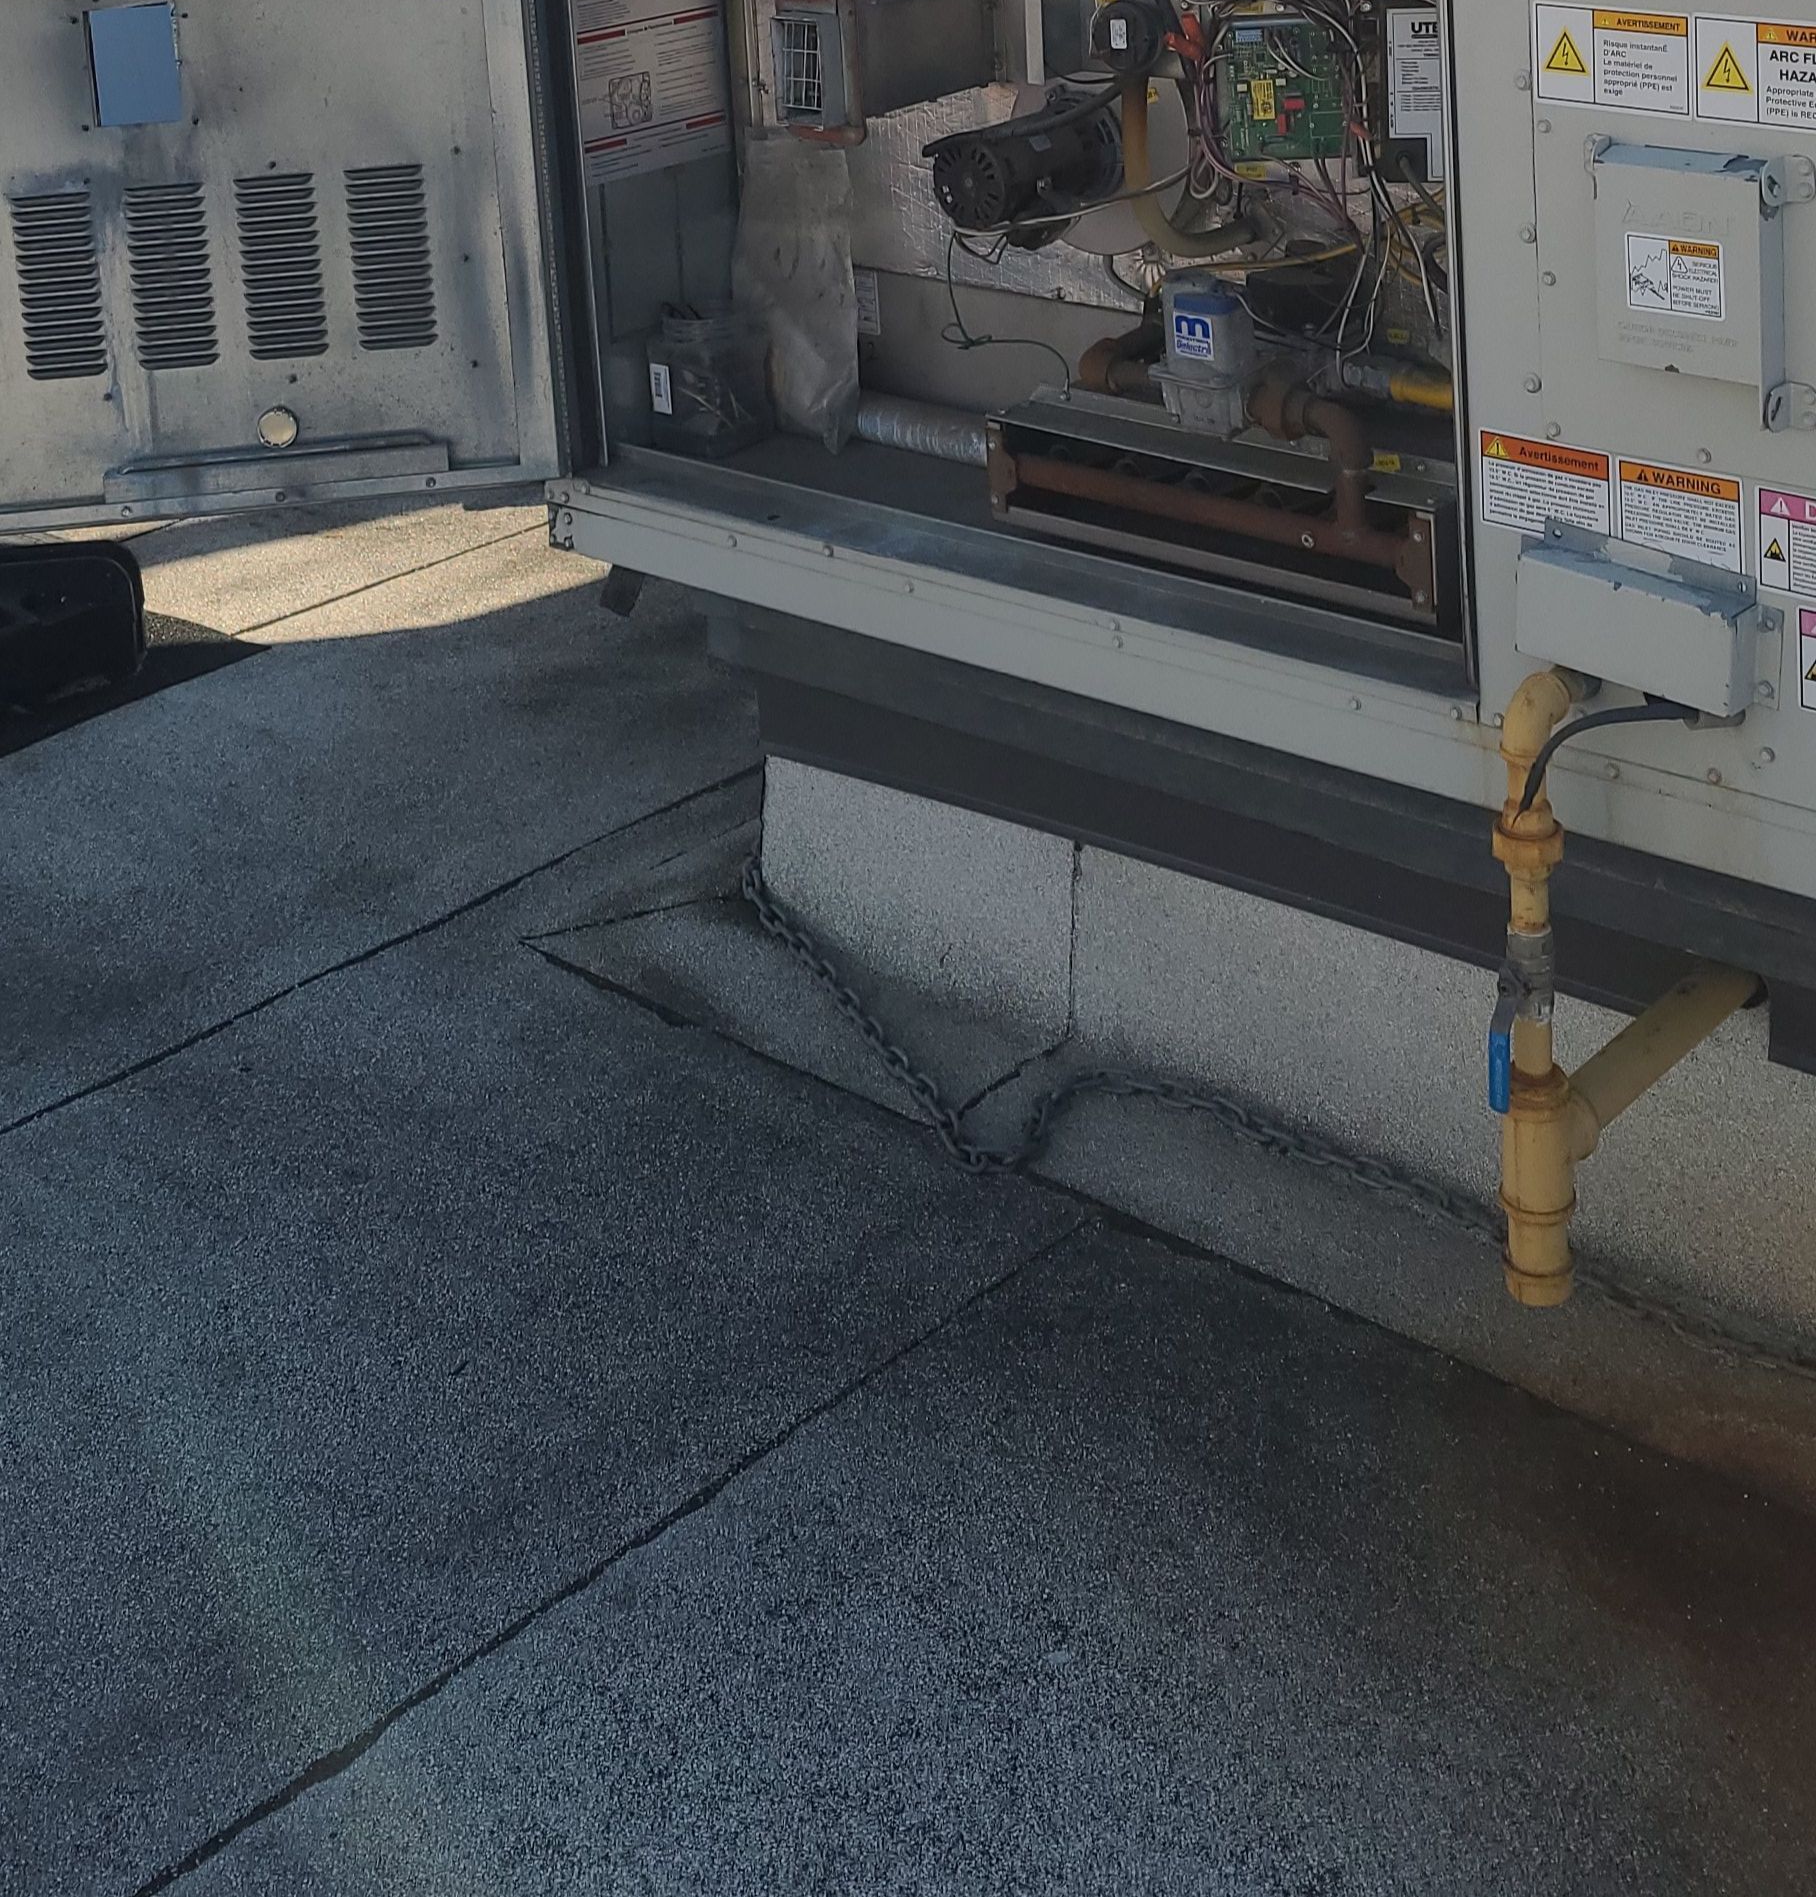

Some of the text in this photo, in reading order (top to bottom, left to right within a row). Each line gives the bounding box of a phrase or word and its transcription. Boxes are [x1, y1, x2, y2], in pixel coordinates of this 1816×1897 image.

[1616, 18, 1681, 32] AVERTISSEMENT
[1603, 39, 1628, 49] Risque
[1603, 49, 1627, 58] D'ARC
[1769, 49, 1800, 64] ARC
[1603, 58, 1612, 66] Le
[1603, 69, 1678, 82] protection personnel
[1639, 81, 1660, 93] (PPE)
[1766, 85, 1814, 98] Appropriate
[1765, 96, 1807, 108] Protective
[1766, 107, 1789, 119] (PPE)
[1791, 110, 1798, 118] is
[1680, 244, 1717, 257] WARNING
[1520, 446, 1600, 471] Avertissement
[1652, 471, 1721, 495] WARNING
